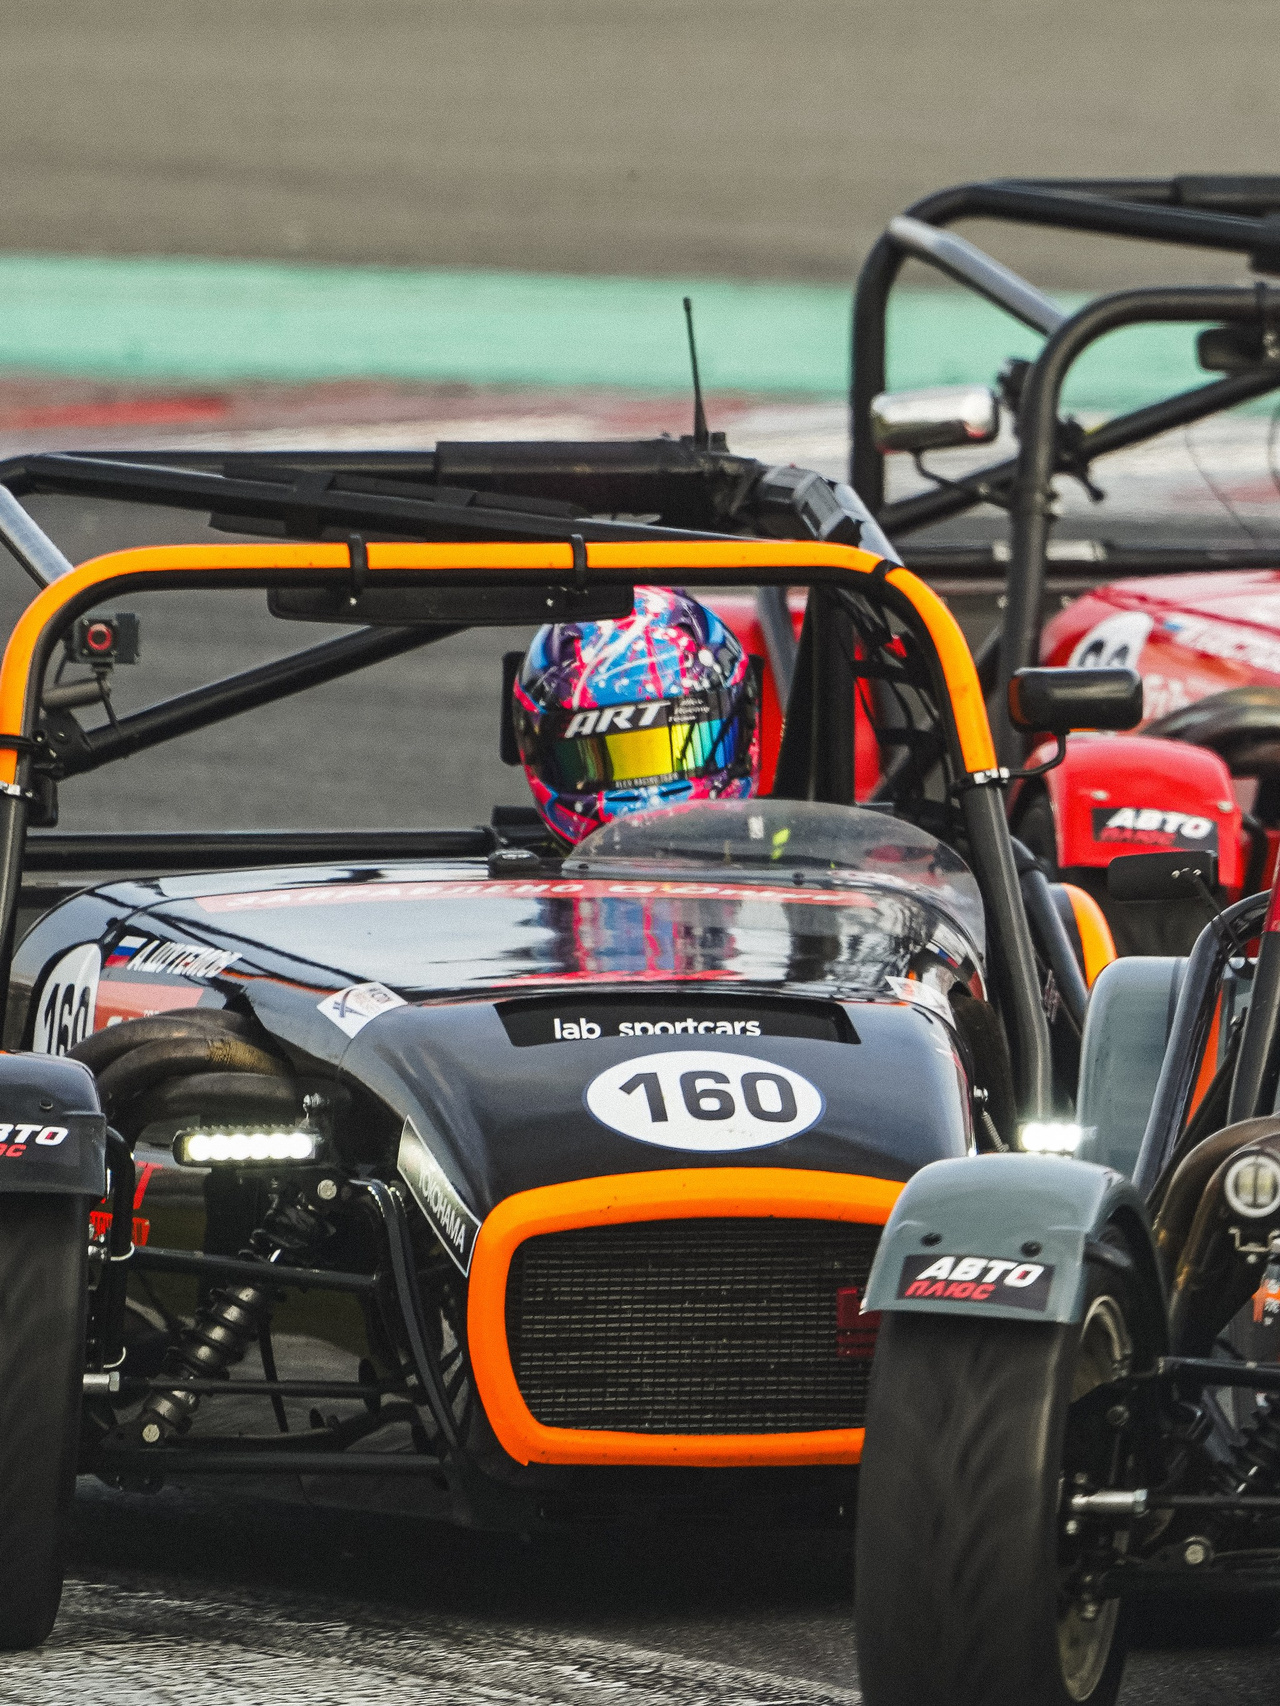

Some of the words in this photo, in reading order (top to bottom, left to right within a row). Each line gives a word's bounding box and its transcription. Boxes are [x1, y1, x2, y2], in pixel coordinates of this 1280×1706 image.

[564, 702, 671, 738] ART
[44, 983, 90, 1055] 160
[554, 1018, 601, 1039] lab
[619, 1018, 761, 1037] sportcars
[619, 1071, 798, 1122] 160
[419, 1163, 467, 1254] YOKOHAMA
[904, 1280, 996, 1300] ПЛЮС
[916, 1256, 1045, 1288] АВТО
